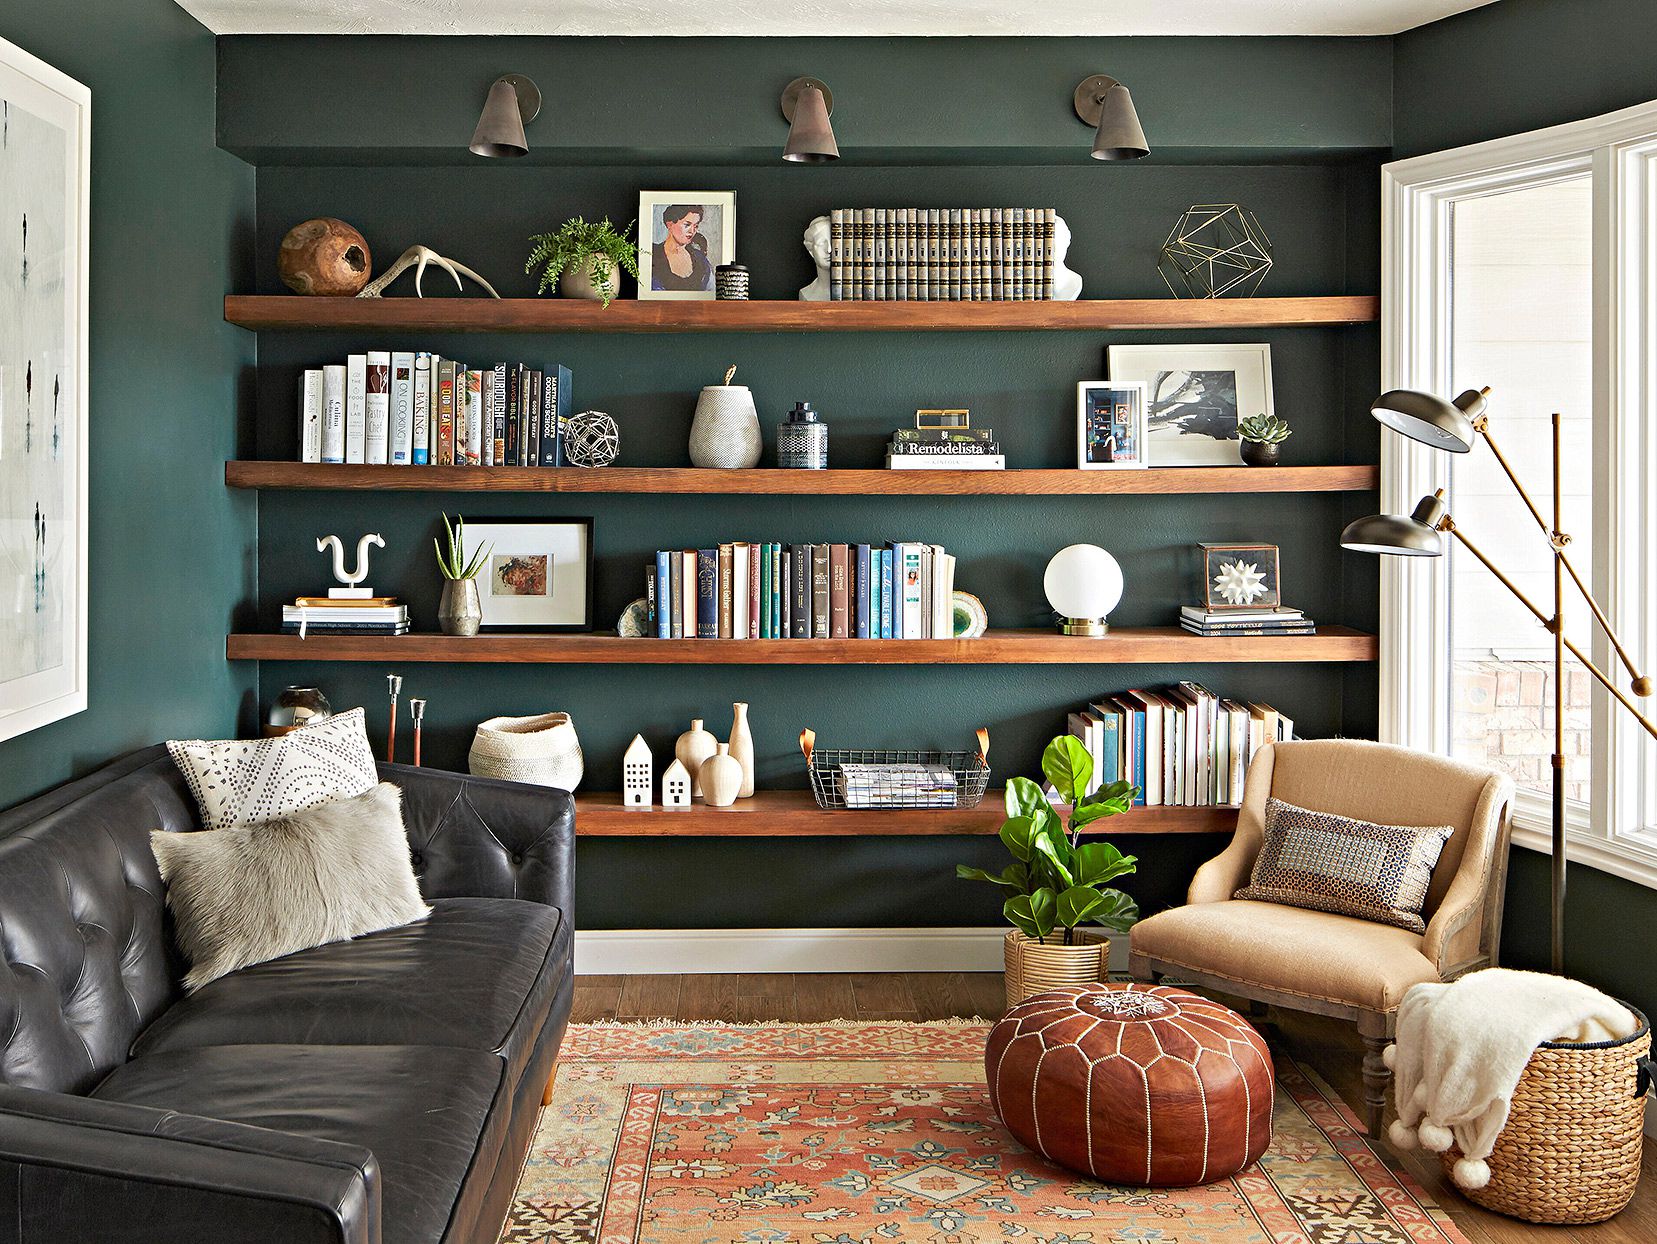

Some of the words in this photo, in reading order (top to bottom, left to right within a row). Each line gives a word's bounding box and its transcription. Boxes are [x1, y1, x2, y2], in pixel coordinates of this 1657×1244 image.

[399, 383, 408, 397] ON
[494, 366, 505, 417] SOURDOUGH
[368, 408, 385, 419] Pastry
[397, 400, 408, 438] COOKING
[415, 392, 425, 435] BAKING
[369, 421, 382, 433] Chef
[909, 442, 983, 454] Remodelista
[699, 570, 715, 599] CHRIST
